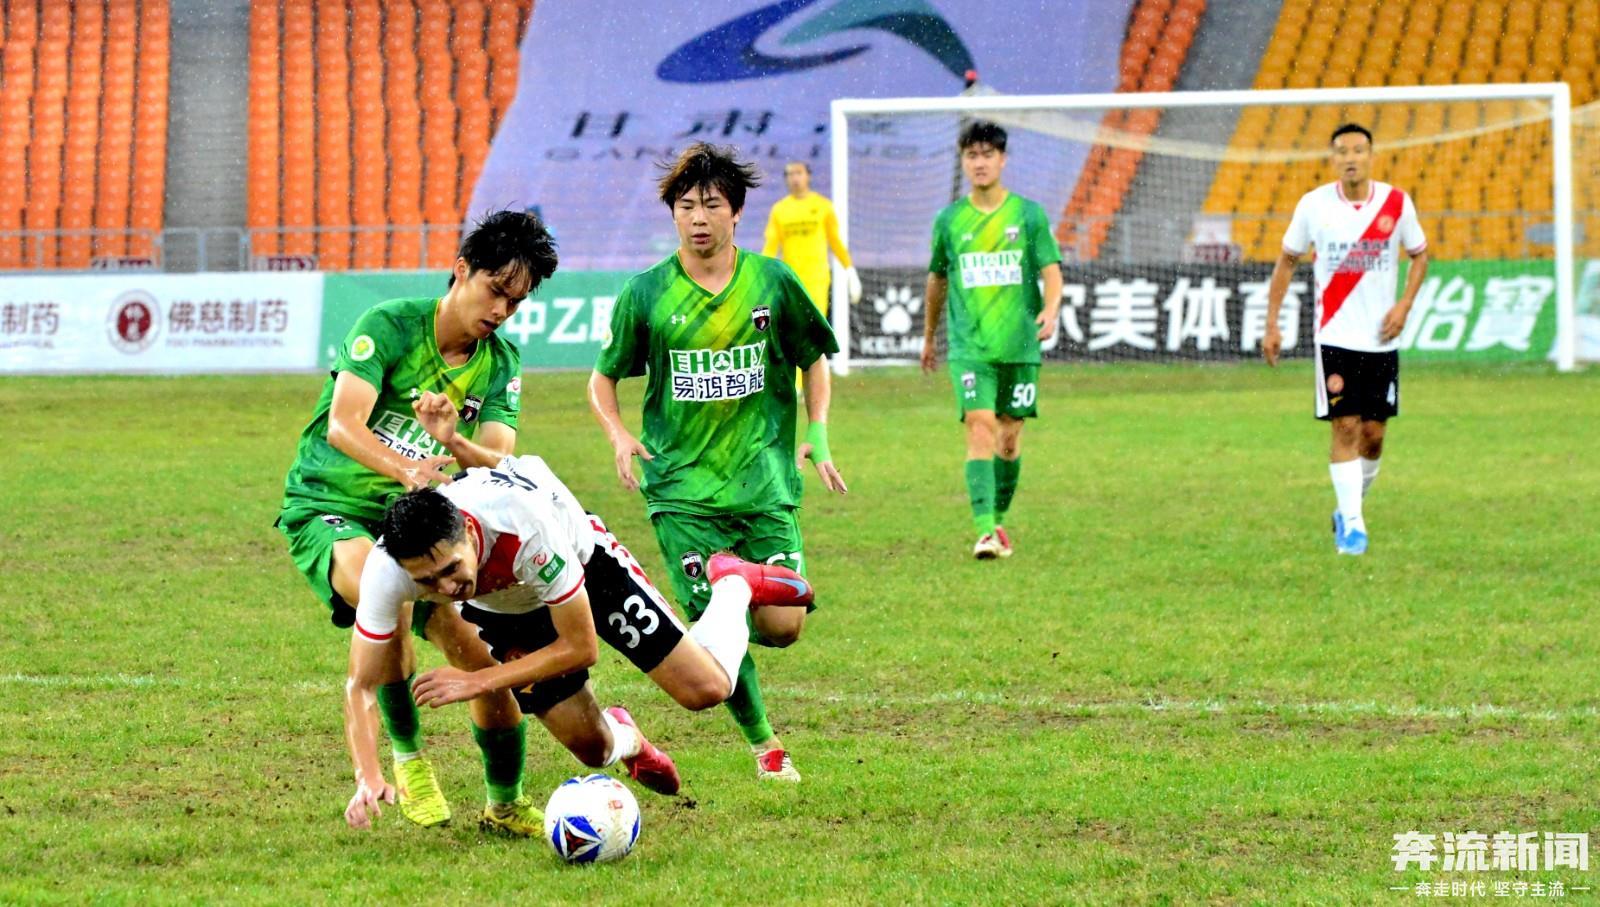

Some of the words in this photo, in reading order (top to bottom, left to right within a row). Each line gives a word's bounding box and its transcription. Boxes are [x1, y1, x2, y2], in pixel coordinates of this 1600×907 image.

[168, 299, 289, 334] 佛慈制药
[674, 368, 765, 400] 易鸿智能
[1011, 383, 1035, 408] 50
[608, 595, 659, 649] 33
